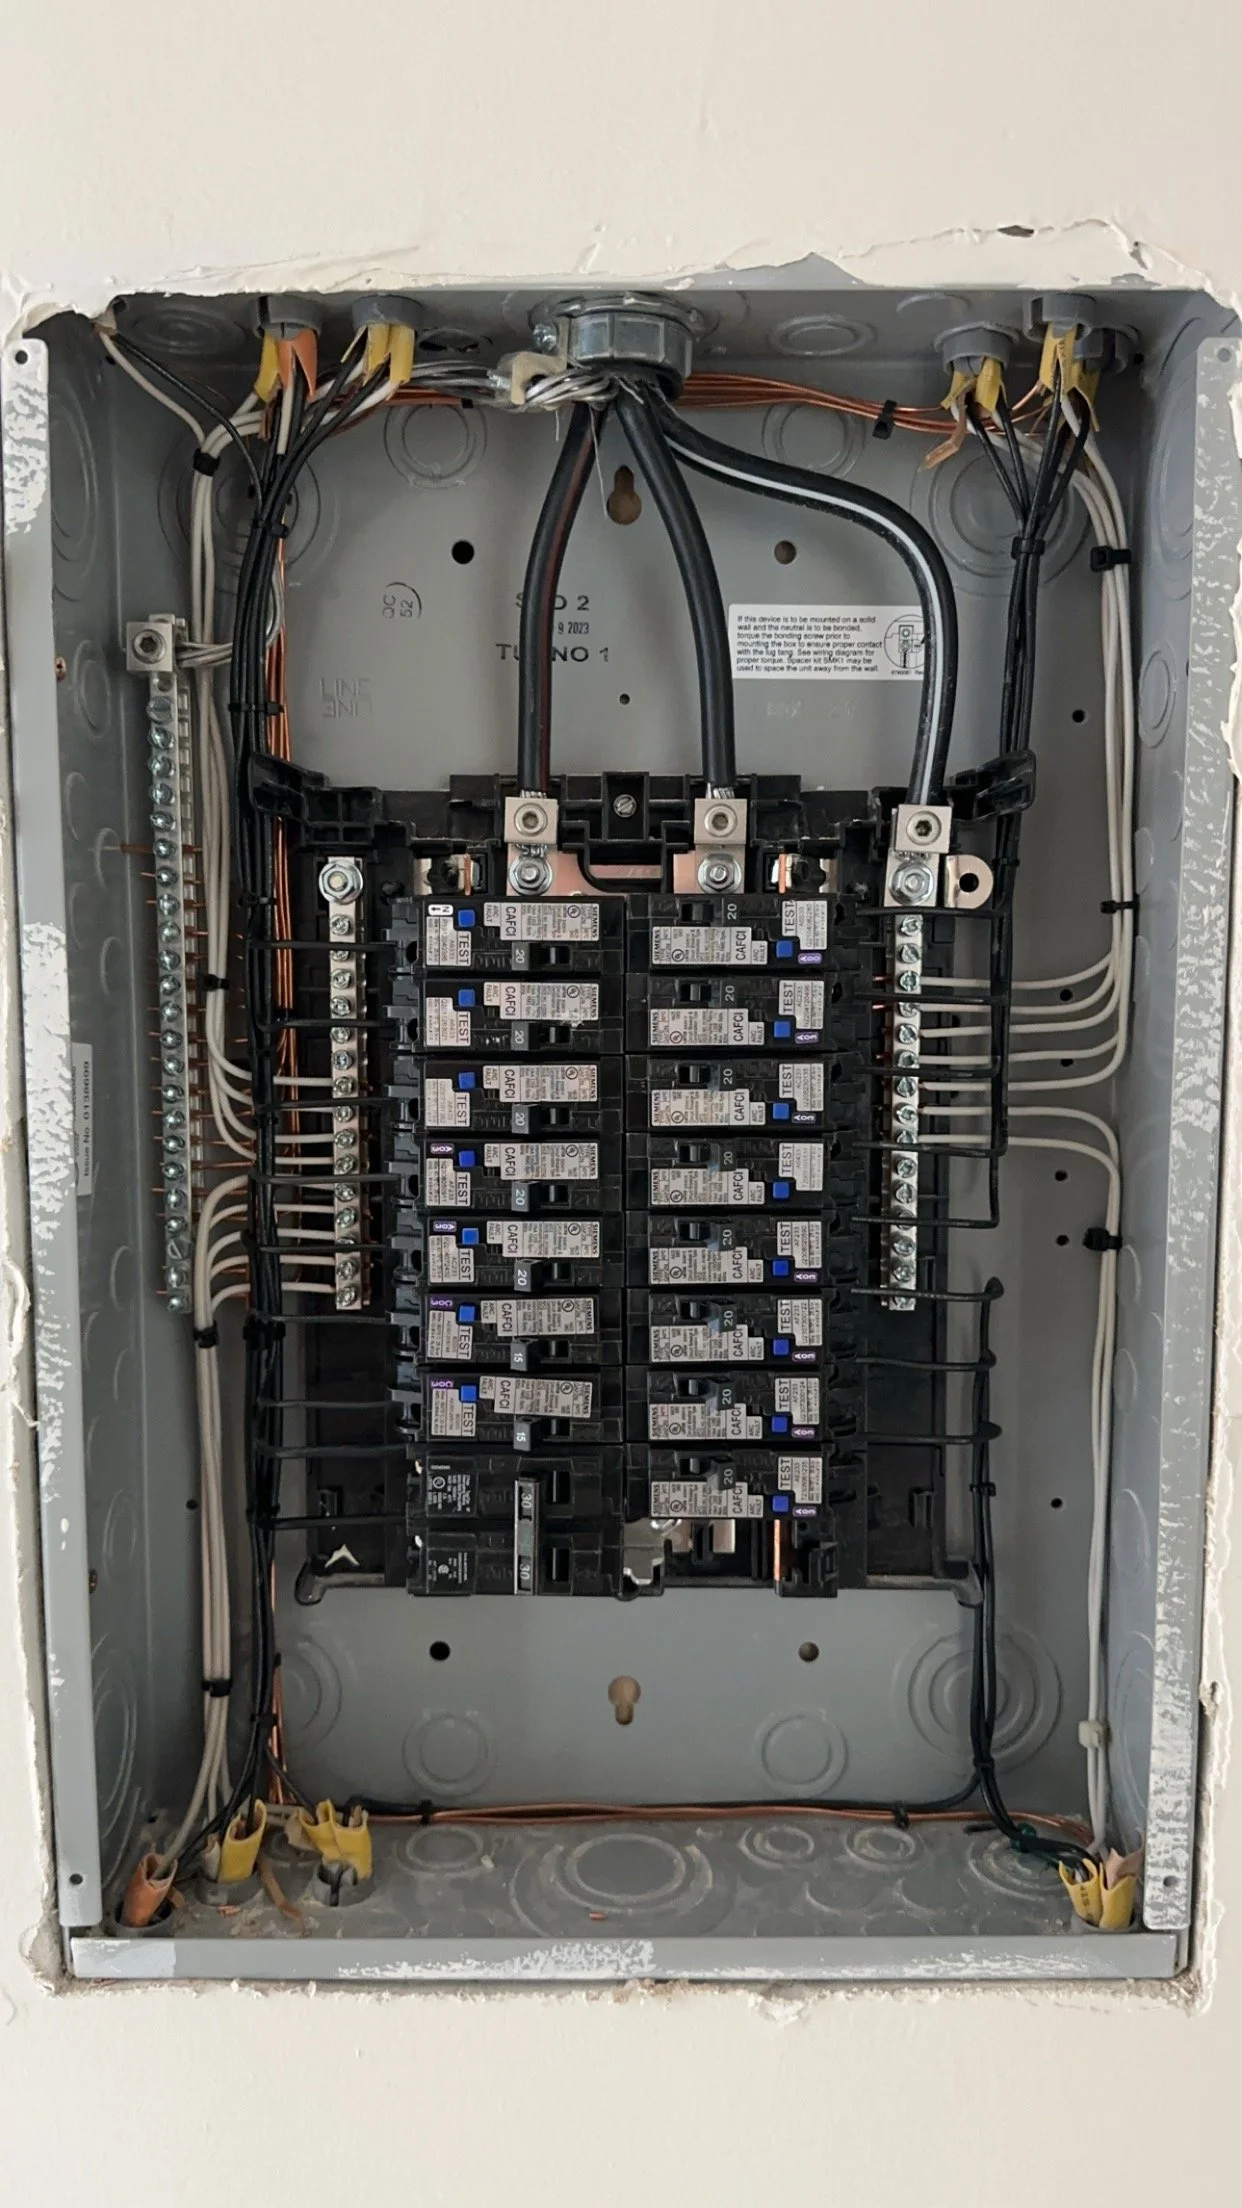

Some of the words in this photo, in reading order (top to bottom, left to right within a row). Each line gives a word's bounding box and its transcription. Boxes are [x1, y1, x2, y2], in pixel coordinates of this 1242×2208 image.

[400, 599, 414, 618] 52
[577, 594, 590, 611] 2
[567, 621, 590, 635] 2023
[737, 632, 759, 641] torque
[774, 632, 802, 641] bonding
[826, 632, 841, 641] prior
[737, 641, 769, 649] mounting
[766, 649, 775, 657] lug
[813, 649, 833, 657] wiring
[835, 649, 863, 657] diagram
[787, 657, 811, 666] Spacer
[505, 906, 516, 936] CAFCI
[727, 903, 737, 920] 20
[785, 902, 794, 933] TEST
[459, 934, 469, 963] TEST
[516, 949, 525, 963] 20
[735, 930, 746, 961] CAFCI
[505, 986, 516, 1016] CAFCI
[725, 985, 734, 1001] 20
[783, 982, 792, 1013] TEST
[459, 1013, 468, 1043] TEST
[515, 1030, 524, 1044] 20
[733, 1012, 743, 1042] CAFCI
[505, 1069, 516, 1098] CAFCI
[723, 1069, 732, 1084] 20
[782, 1064, 792, 1095] TEST
[457, 1095, 467, 1125] TEST
[516, 1112, 525, 1126] 20
[734, 1092, 745, 1121] CAFCI
[505, 1147, 516, 1176] CAFCI
[723, 1151, 732, 1164] 20
[782, 1144, 791, 1174] TEST
[458, 1175, 468, 1205] TEST
[516, 1189, 525, 1205] 20
[733, 1171, 743, 1200] CAFCI
[508, 1224, 518, 1253] CAFCI
[723, 1229, 732, 1246] 20
[781, 1223, 790, 1253] TEST
[461, 1250, 471, 1280] TEST
[517, 1270, 527, 1286] 20
[732, 1250, 743, 1279] CAFCI
[502, 1303, 512, 1332] CAFCI
[723, 1310, 733, 1327] 20
[781, 1302, 790, 1331] TEST
[460, 1327, 470, 1358] TEST
[732, 1328, 743, 1357] CAFCI
[514, 1352, 523, 1363] 15
[499, 1380, 511, 1409] CAFCI
[722, 1388, 731, 1405] 20
[779, 1379, 788, 1409] TEST
[464, 1405, 474, 1435] TEST
[731, 1407, 741, 1435] CAFCI
[516, 1431, 526, 1442] 15
[723, 1468, 733, 1484] 20
[781, 1457, 790, 1487] TEST
[521, 1493, 531, 1508] 30
[732, 1484, 742, 1513] CAFCI
[520, 1564, 530, 1580] 30
